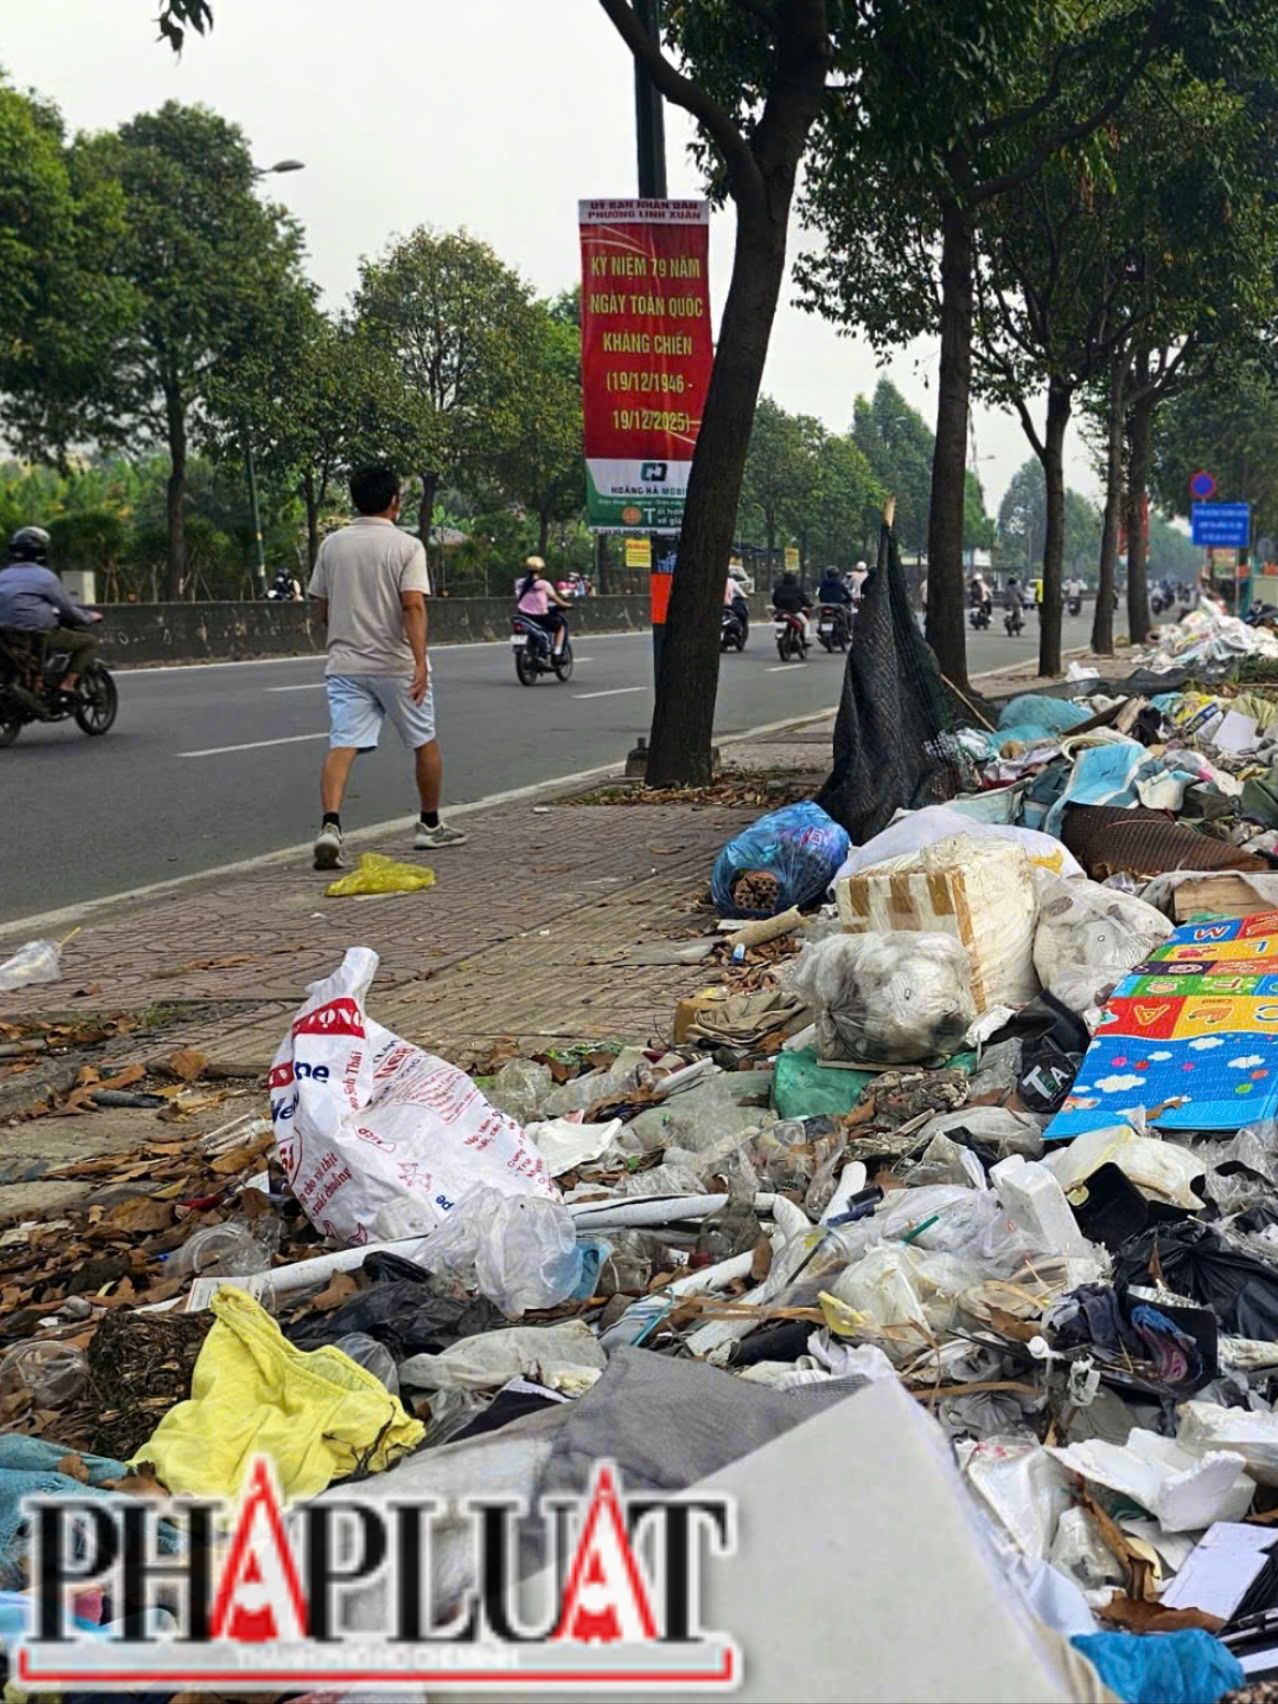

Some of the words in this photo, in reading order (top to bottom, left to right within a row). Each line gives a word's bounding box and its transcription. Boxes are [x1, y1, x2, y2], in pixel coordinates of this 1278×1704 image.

[609, 200, 634, 210] BAN
[639, 210, 665, 220] LINH
[611, 252, 647, 280] NIỆM
[651, 258, 667, 278] 79
[670, 255, 700, 278] NĂM
[590, 291, 626, 314] NGÀY
[629, 291, 665, 316] TOÀN
[668, 289, 703, 318] QUỐC
[603, 330, 650, 353] KHÁNG
[654, 330, 692, 355] CHIẾN
[606, 371, 685, 394] (19/12/1946
[613, 409, 691, 433] 19/12/2025)
[645, 485, 658, 495] HÀ
[662, 487, 686, 495] MOBI
